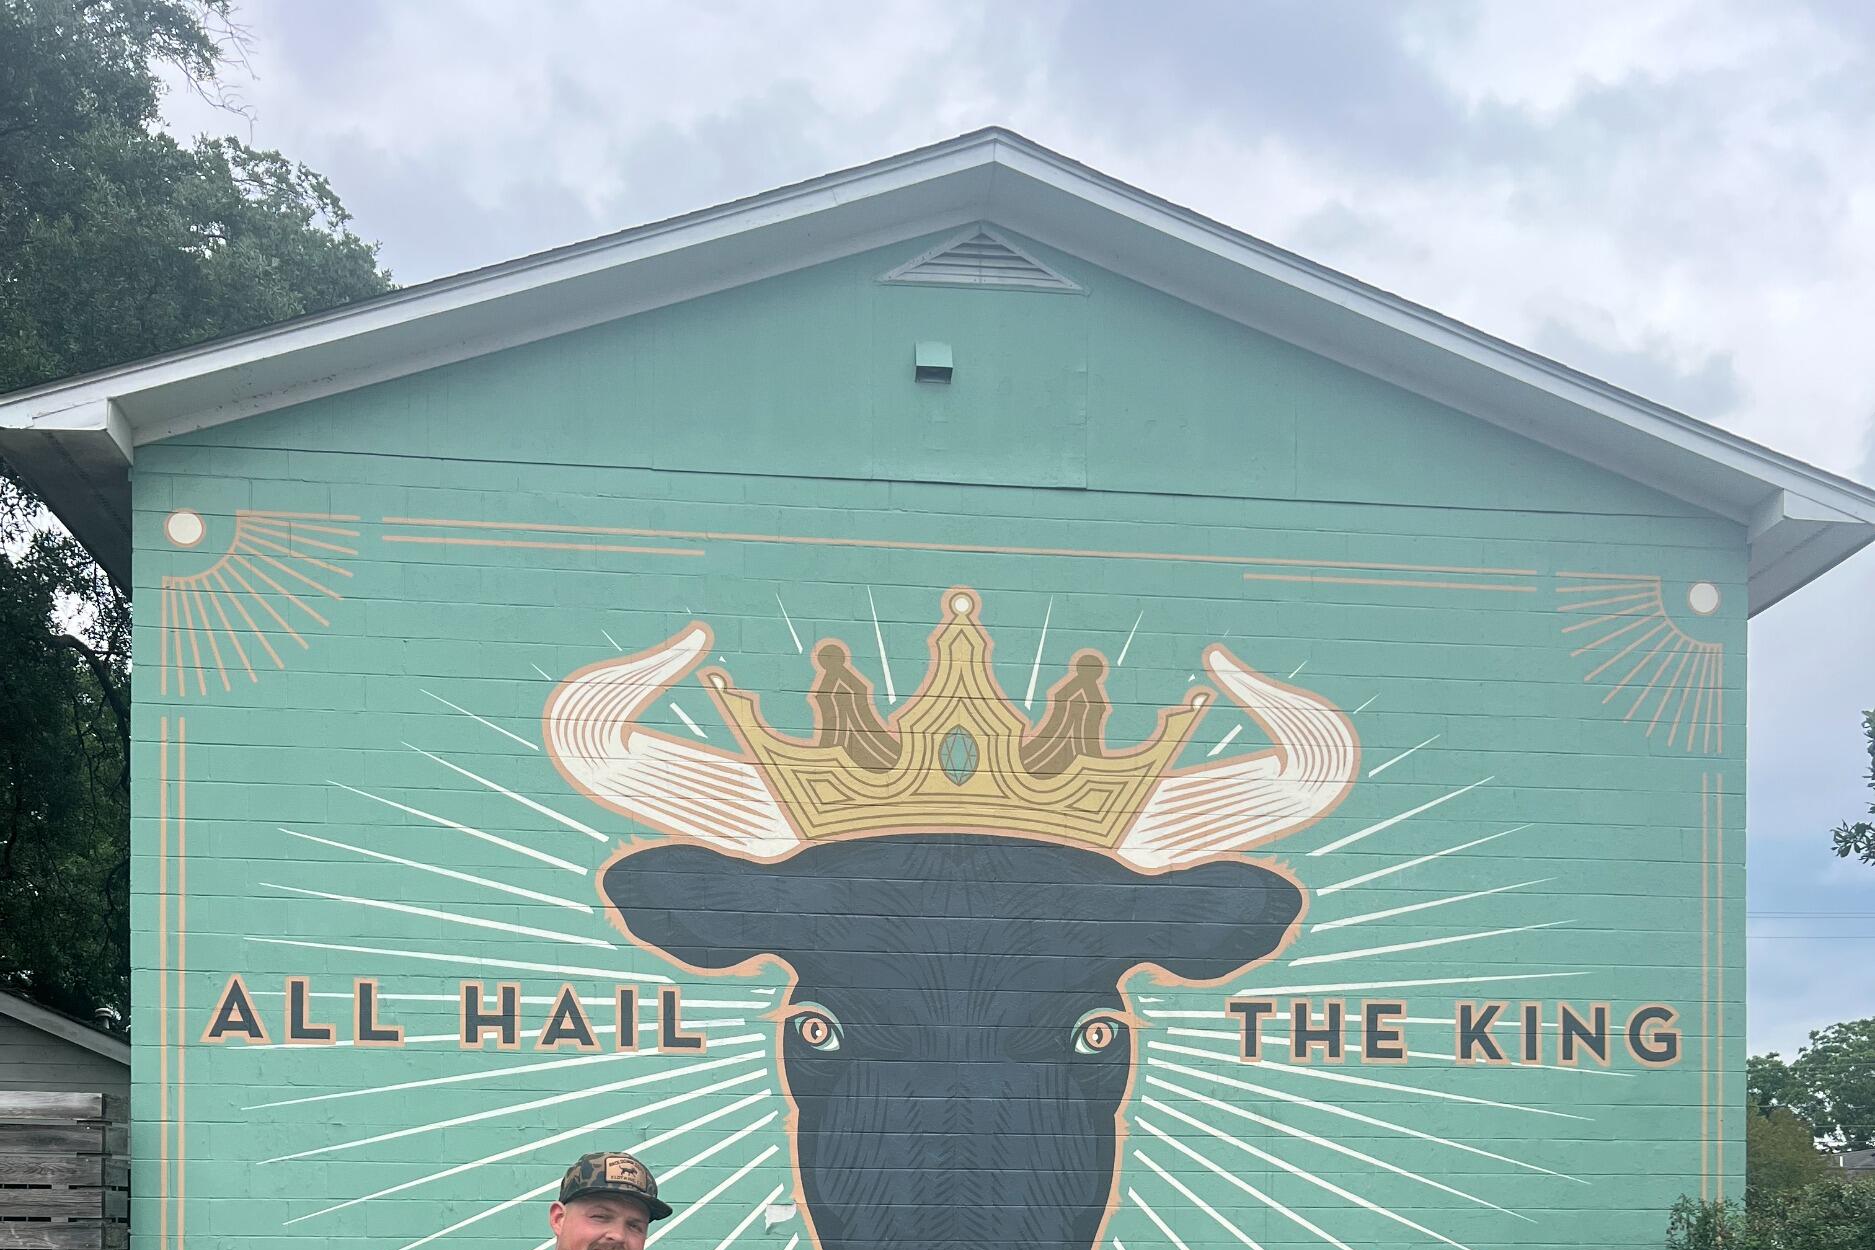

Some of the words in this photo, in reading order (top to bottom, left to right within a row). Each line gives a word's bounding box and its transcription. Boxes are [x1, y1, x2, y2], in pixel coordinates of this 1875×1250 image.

[200, 973, 405, 1047] ALL
[459, 980, 707, 1054] HAIL
[1225, 998, 1408, 1065] THE
[1455, 999, 1683, 1068] KING
